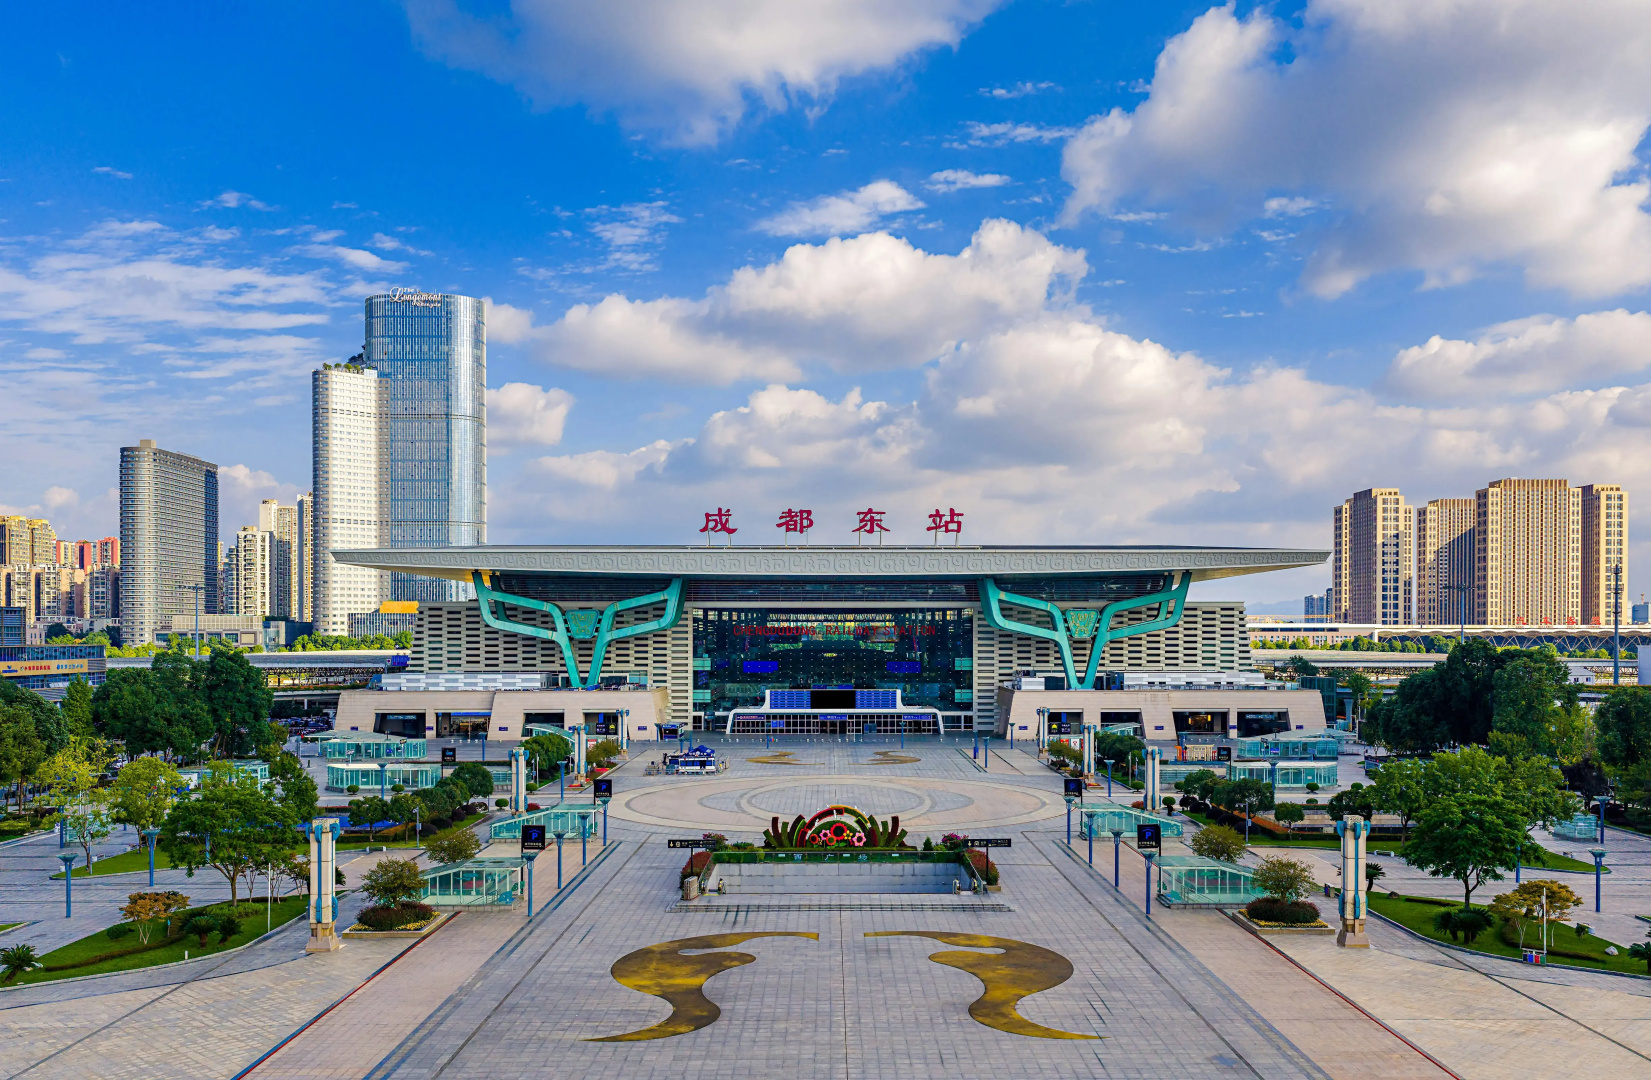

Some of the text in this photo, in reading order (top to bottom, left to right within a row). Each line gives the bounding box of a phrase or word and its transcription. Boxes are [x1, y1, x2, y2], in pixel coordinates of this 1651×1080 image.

[699, 507, 964, 534] 成都东站
[733, 625, 936, 636] CHENGDUDONG RAILWAY STATION
